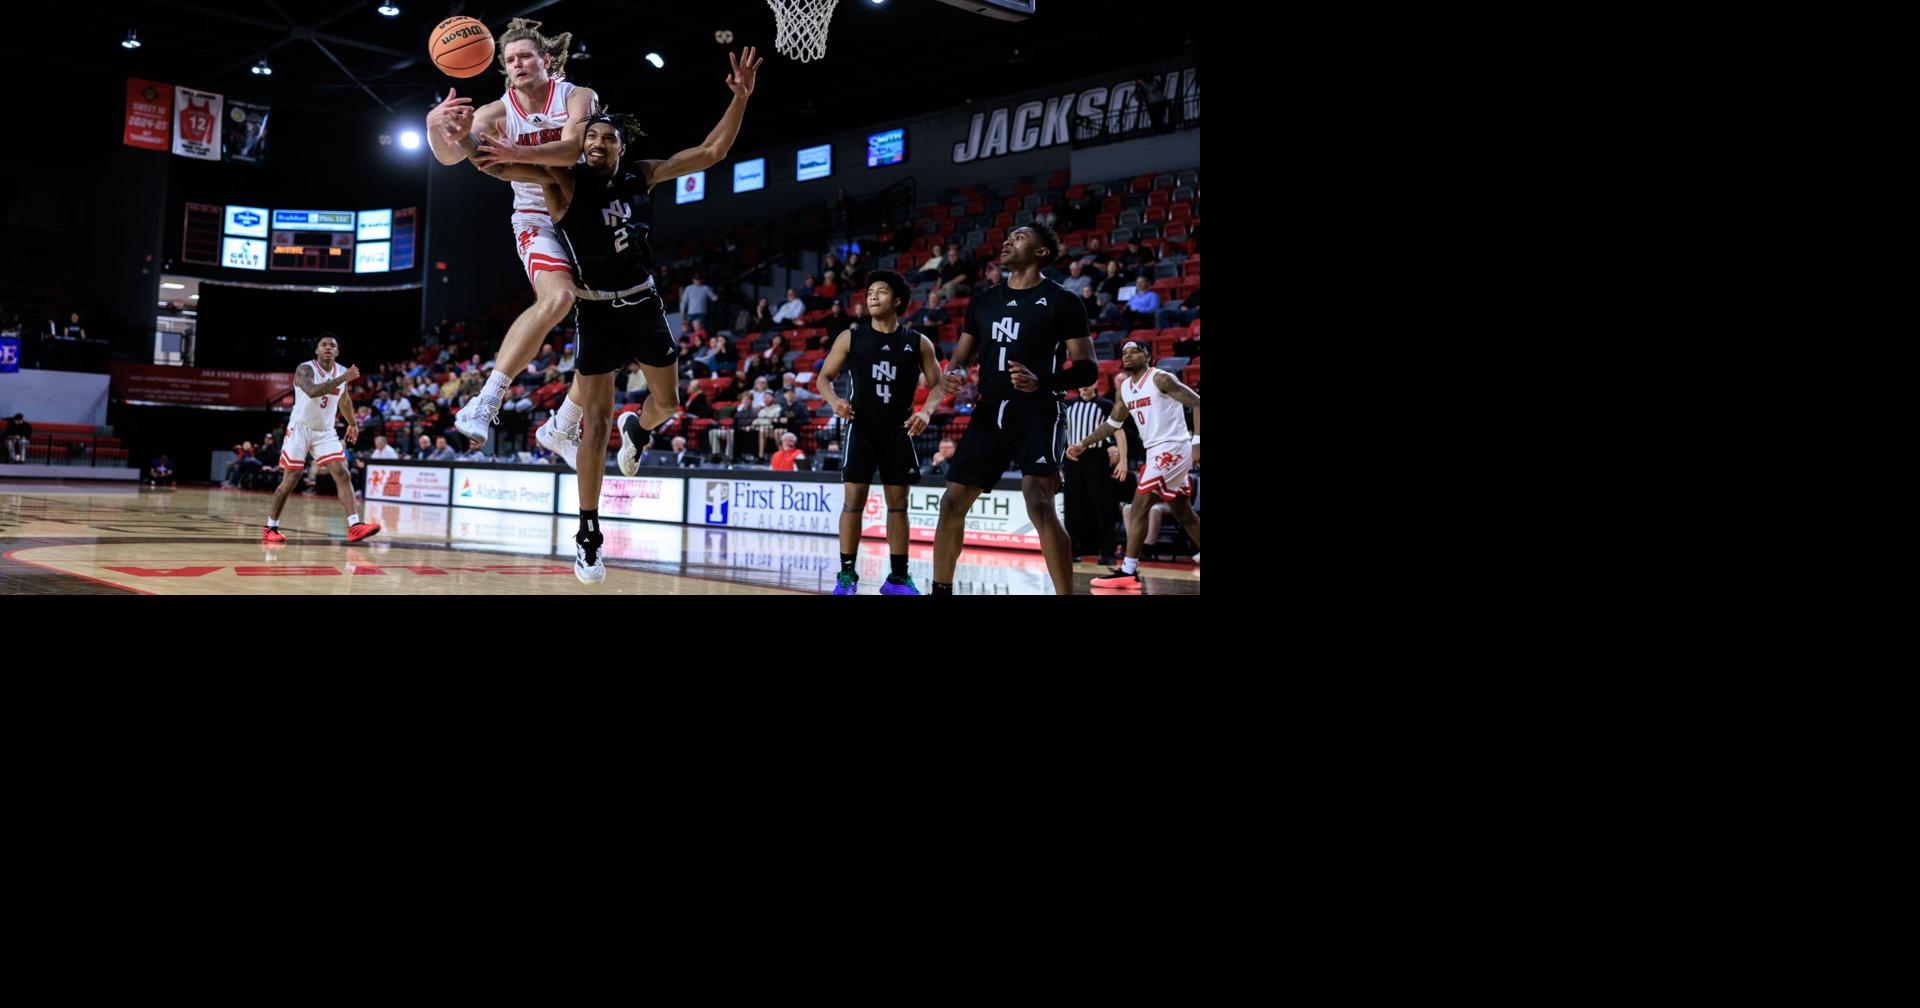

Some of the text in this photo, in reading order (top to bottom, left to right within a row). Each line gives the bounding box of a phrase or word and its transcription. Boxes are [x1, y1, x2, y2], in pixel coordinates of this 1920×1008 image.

[441, 25, 484, 45] Wilson
[189, 117, 207, 131] 12
[614, 227, 630, 253] 2
[230, 259, 258, 267] MART
[0, 345, 17, 364] E
[998, 347, 1006, 371] 1
[217, 371, 240, 379] STATE
[320, 396, 329, 409] 3
[876, 384, 892, 404] 4
[1137, 411, 1145, 425] 0
[477, 485, 551, 503] Alabama Power
[733, 482, 832, 513] First Bank
[733, 512, 831, 531] OF ALABAMA
[984, 521, 1007, 532] LLC
